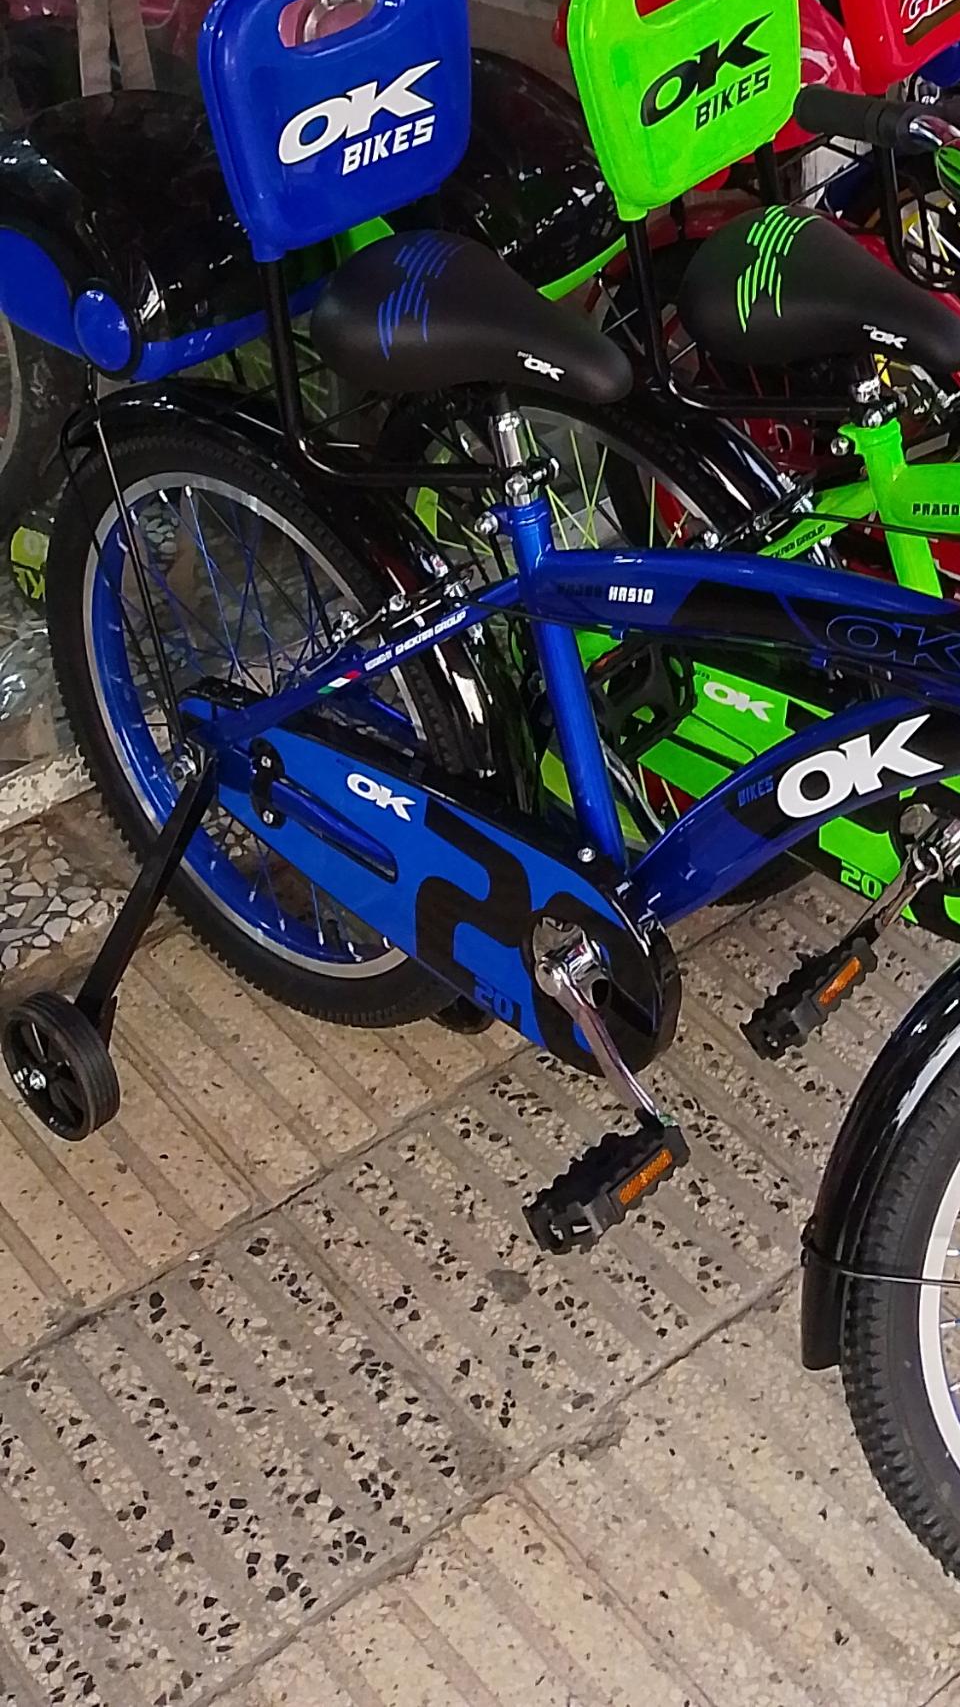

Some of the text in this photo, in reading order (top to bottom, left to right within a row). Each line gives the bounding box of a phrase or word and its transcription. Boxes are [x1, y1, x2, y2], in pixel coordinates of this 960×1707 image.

[640, 11, 773, 127] OK
[695, 65, 772, 131] BIKES
[278, 60, 440, 165] OK
[341, 115, 436, 176] BIKES
[524, 357, 565, 382] OK
[869, 330, 908, 350] OK
[703, 681, 776, 724] OK
[777, 713, 945, 818] OK
[346, 773, 417, 822] OK
